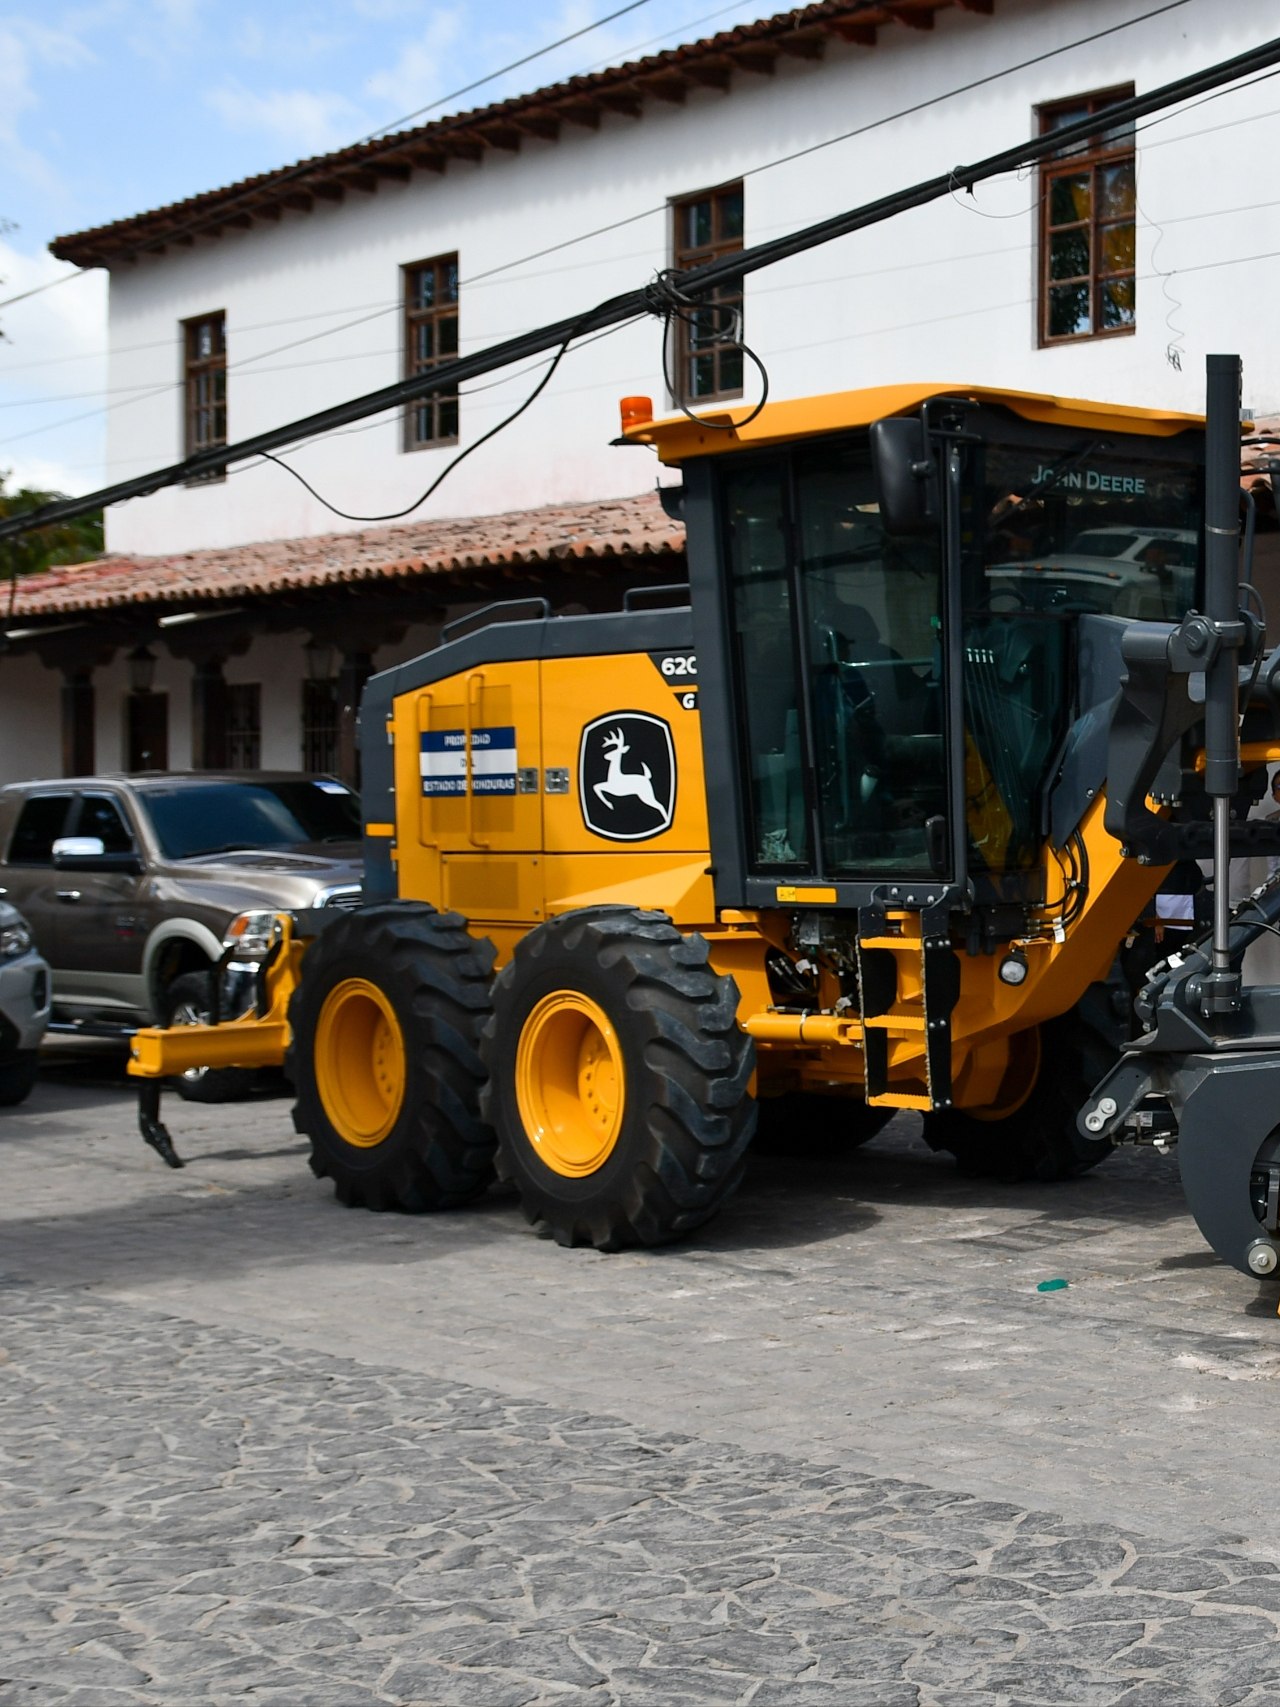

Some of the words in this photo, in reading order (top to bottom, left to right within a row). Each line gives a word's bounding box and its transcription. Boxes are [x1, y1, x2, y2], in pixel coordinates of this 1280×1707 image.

[1086, 470, 1145, 494] DEERE
[444, 734, 491, 746] PROPEDAD
[460, 758, 476, 768] DL
